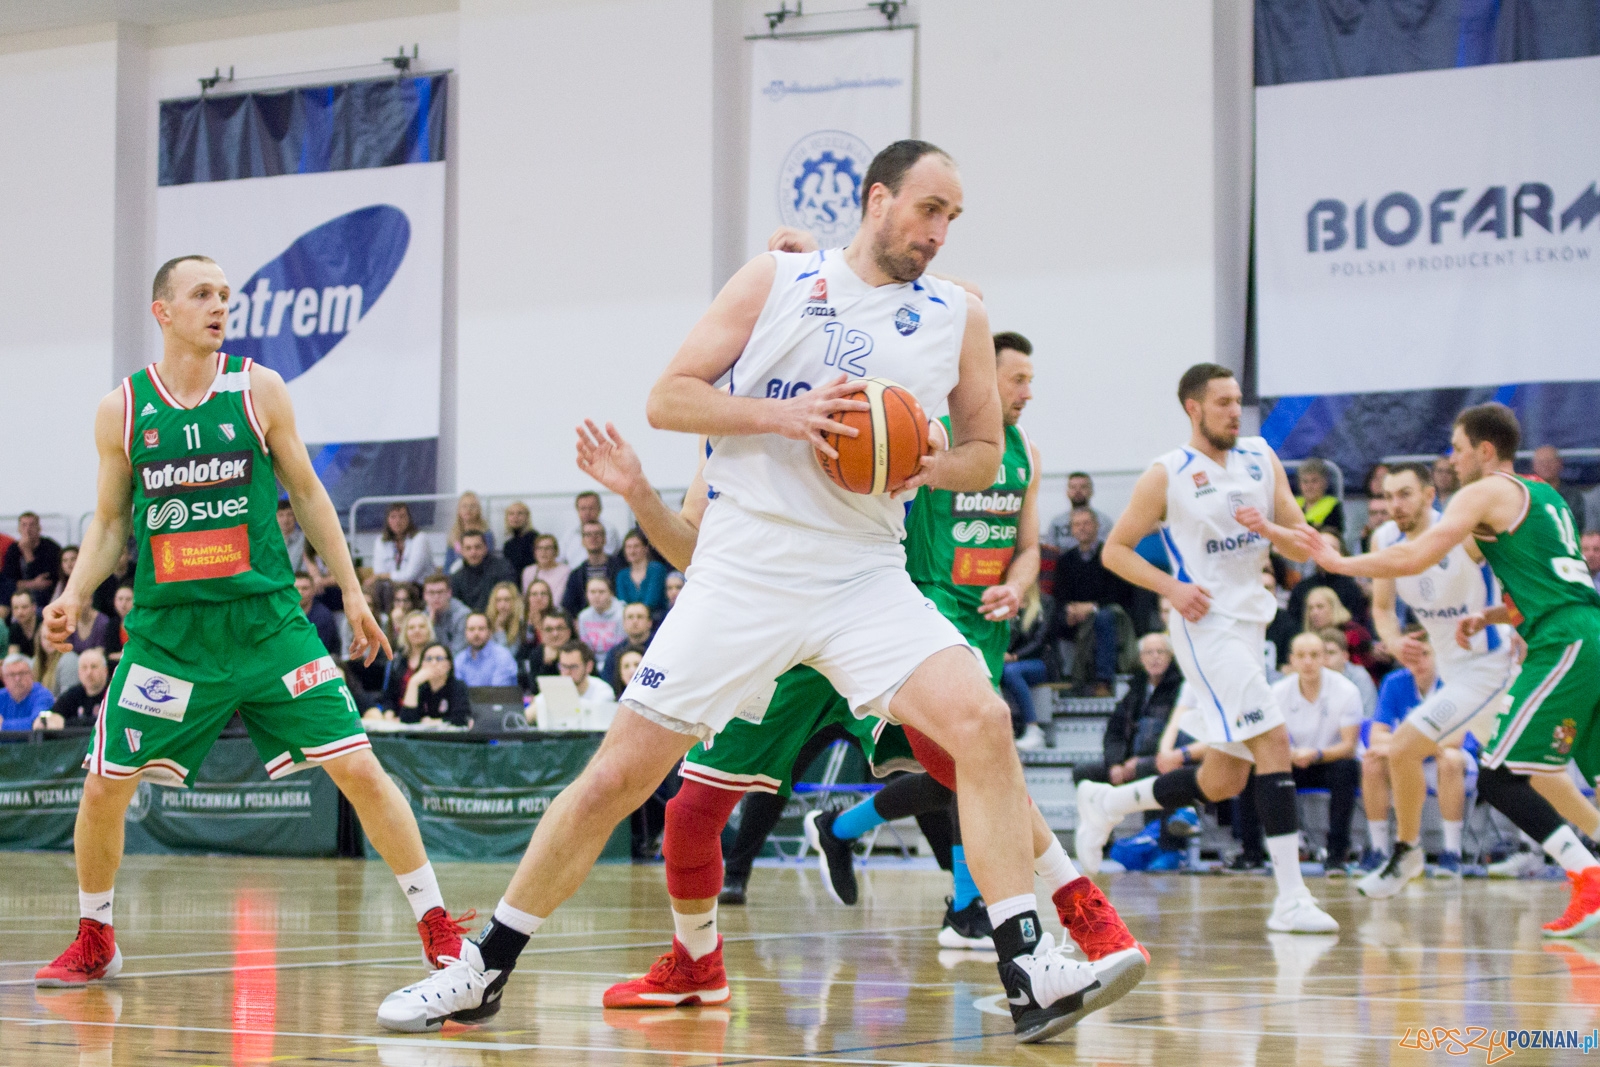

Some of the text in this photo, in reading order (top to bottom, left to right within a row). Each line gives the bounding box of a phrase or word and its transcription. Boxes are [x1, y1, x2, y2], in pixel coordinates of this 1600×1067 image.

[1331, 245, 1592, 277] POLSKI PRODUCENT LEKÓW
[225, 278, 363, 340] atrem
[823, 321, 874, 377] 12
[183, 423, 201, 450] 11
[143, 458, 248, 490] totolotek
[955, 492, 1022, 512] totolote
[181, 543, 233, 557] TRAMWAJE
[181, 550, 242, 567] WARSZAWSKIE
[122, 697, 143, 710] Fracht
[144, 704, 161, 714] FWO
[161, 789, 311, 808] POLITECHNIKA POZNAŃSKA
[422, 797, 551, 813] POLITECHNIKA POZN
